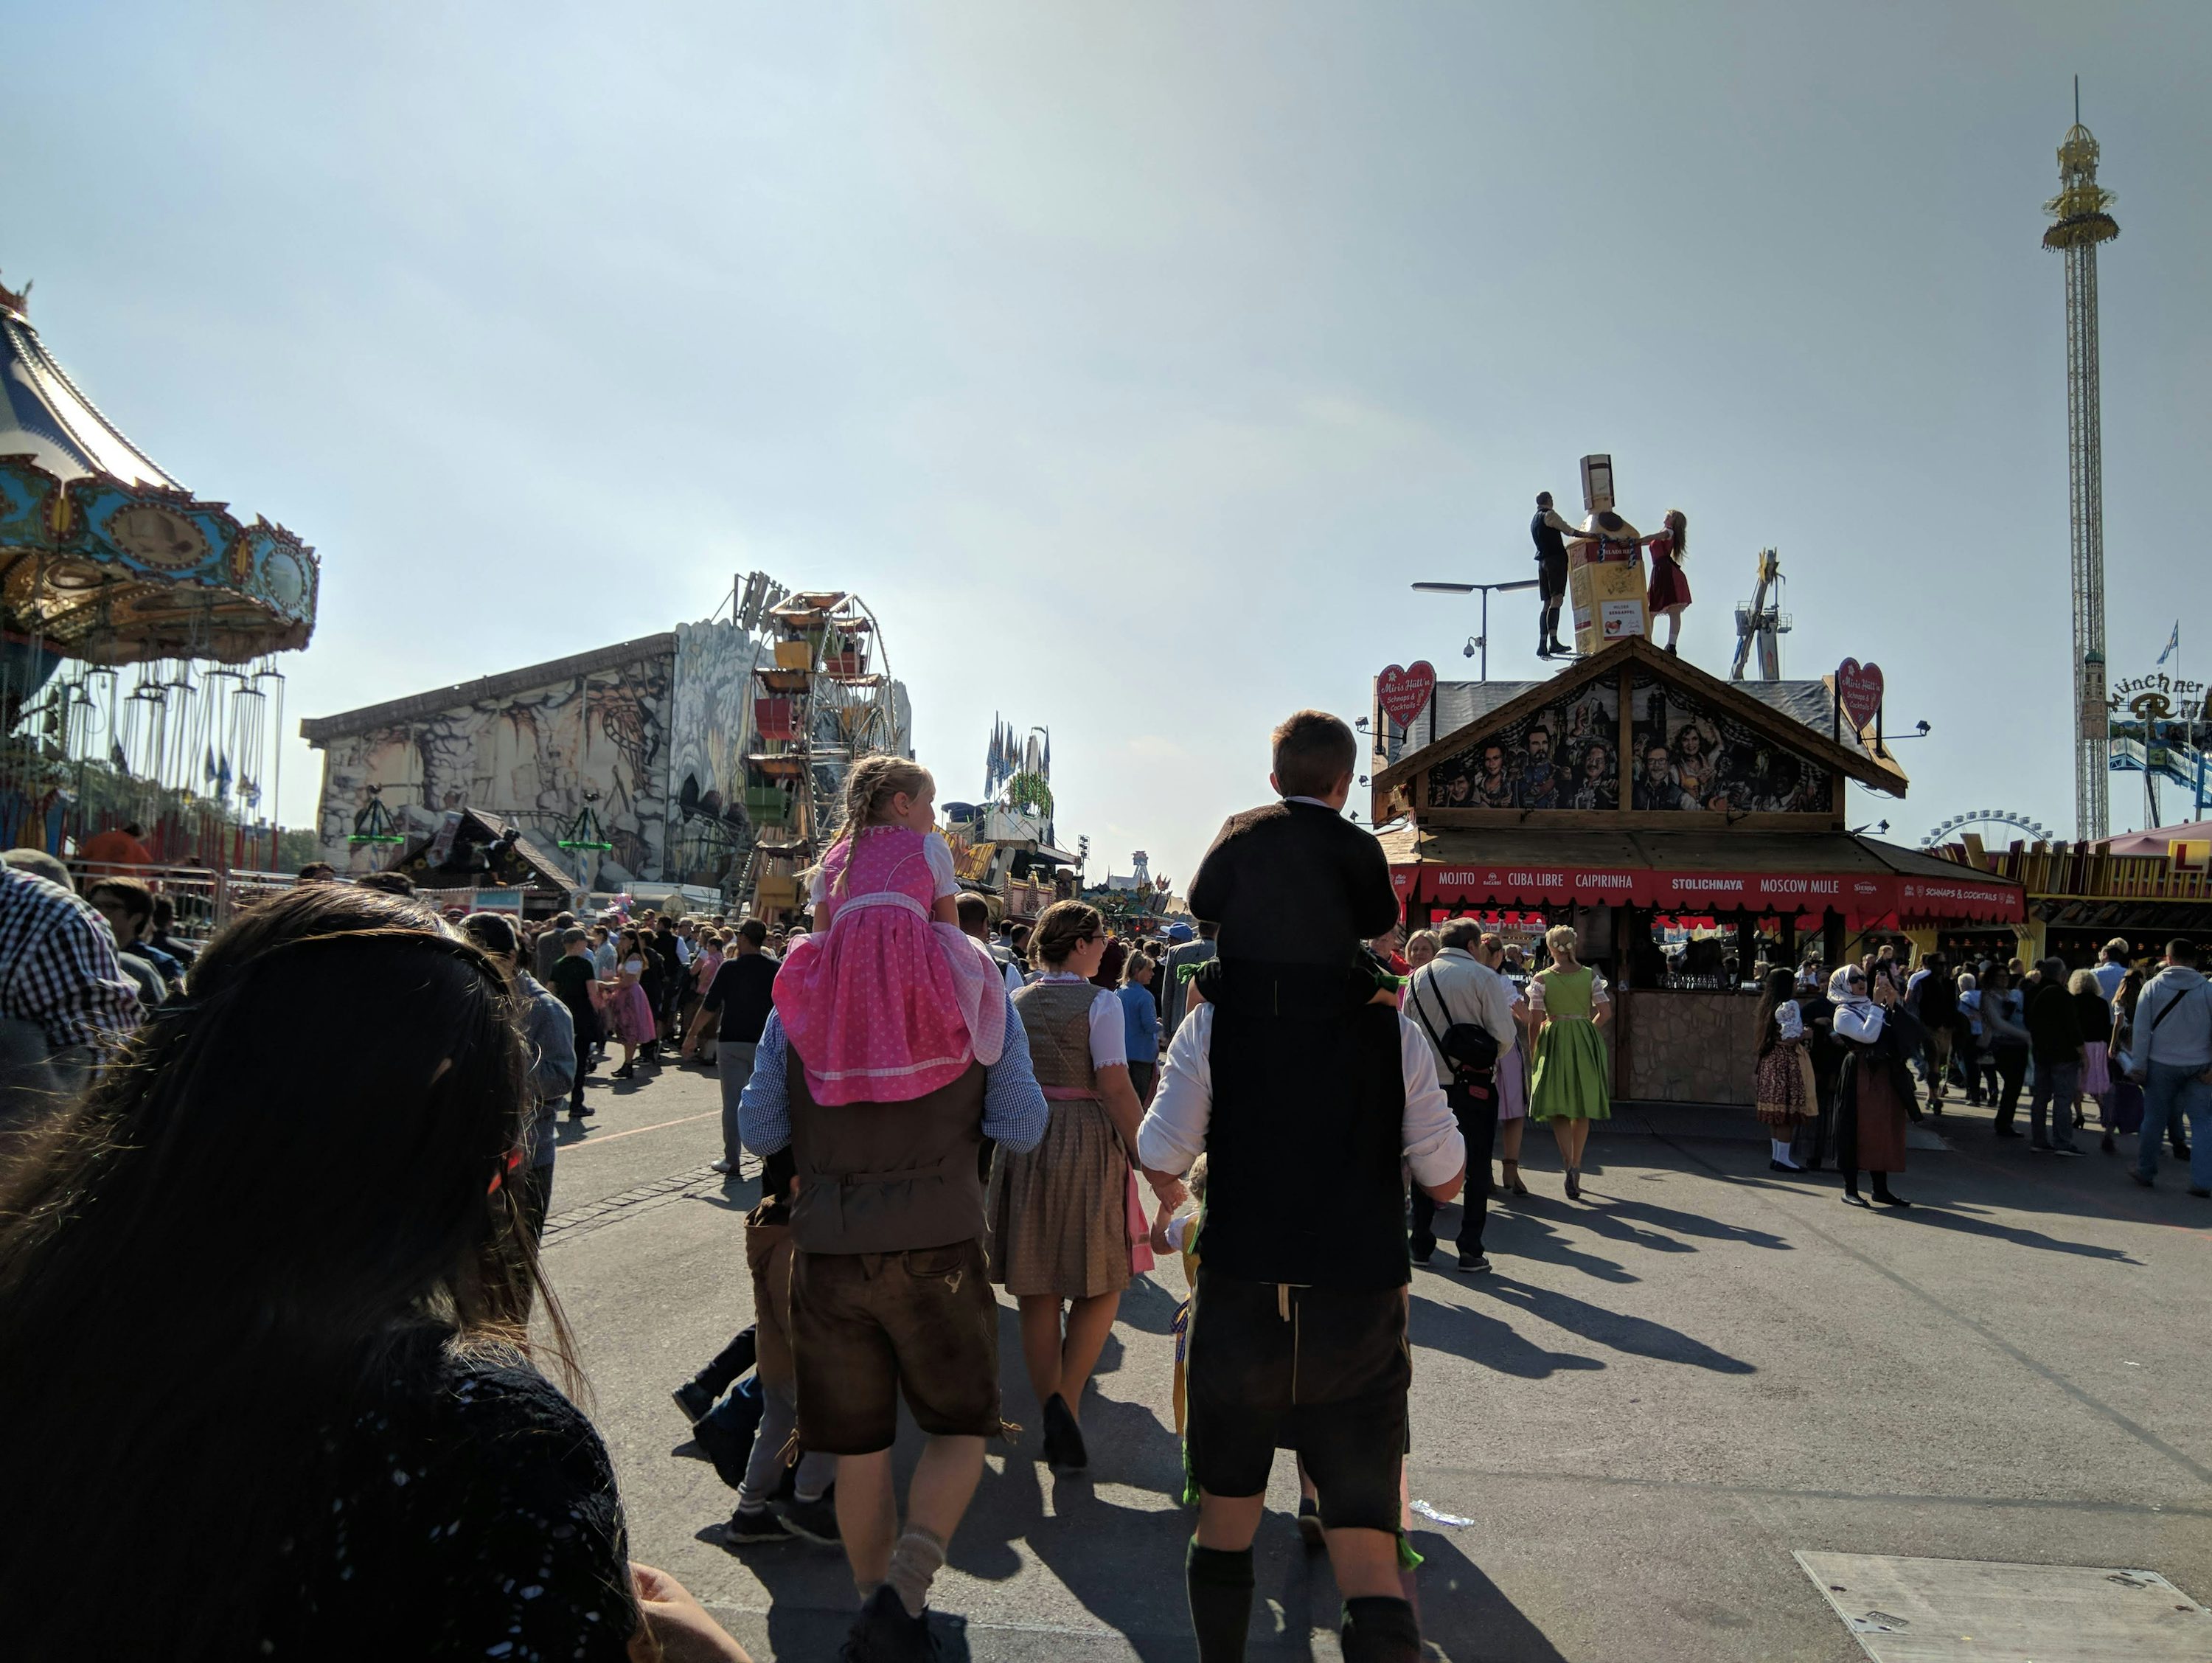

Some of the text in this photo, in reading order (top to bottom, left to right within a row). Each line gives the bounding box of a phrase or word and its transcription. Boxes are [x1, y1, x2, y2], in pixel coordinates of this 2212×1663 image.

[2105, 672, 2204, 713] Münchner
[1391, 702, 1416, 711] Cocktails
[2174, 844, 2203, 870] L
[1439, 872, 1475, 885] MOJITO
[1508, 872, 1564, 886] CUBA LIBRE
[1575, 874, 1633, 889] CAIPIRINHA
[1672, 878, 1743, 890] STOLICHNAYA
[1760, 879, 1840, 894] MOSCOW MULE
[1925, 888, 1955, 898] SCHNAPS
[1956, 889, 1963, 899] &
[1963, 891, 1997, 901] COCKTAILS
